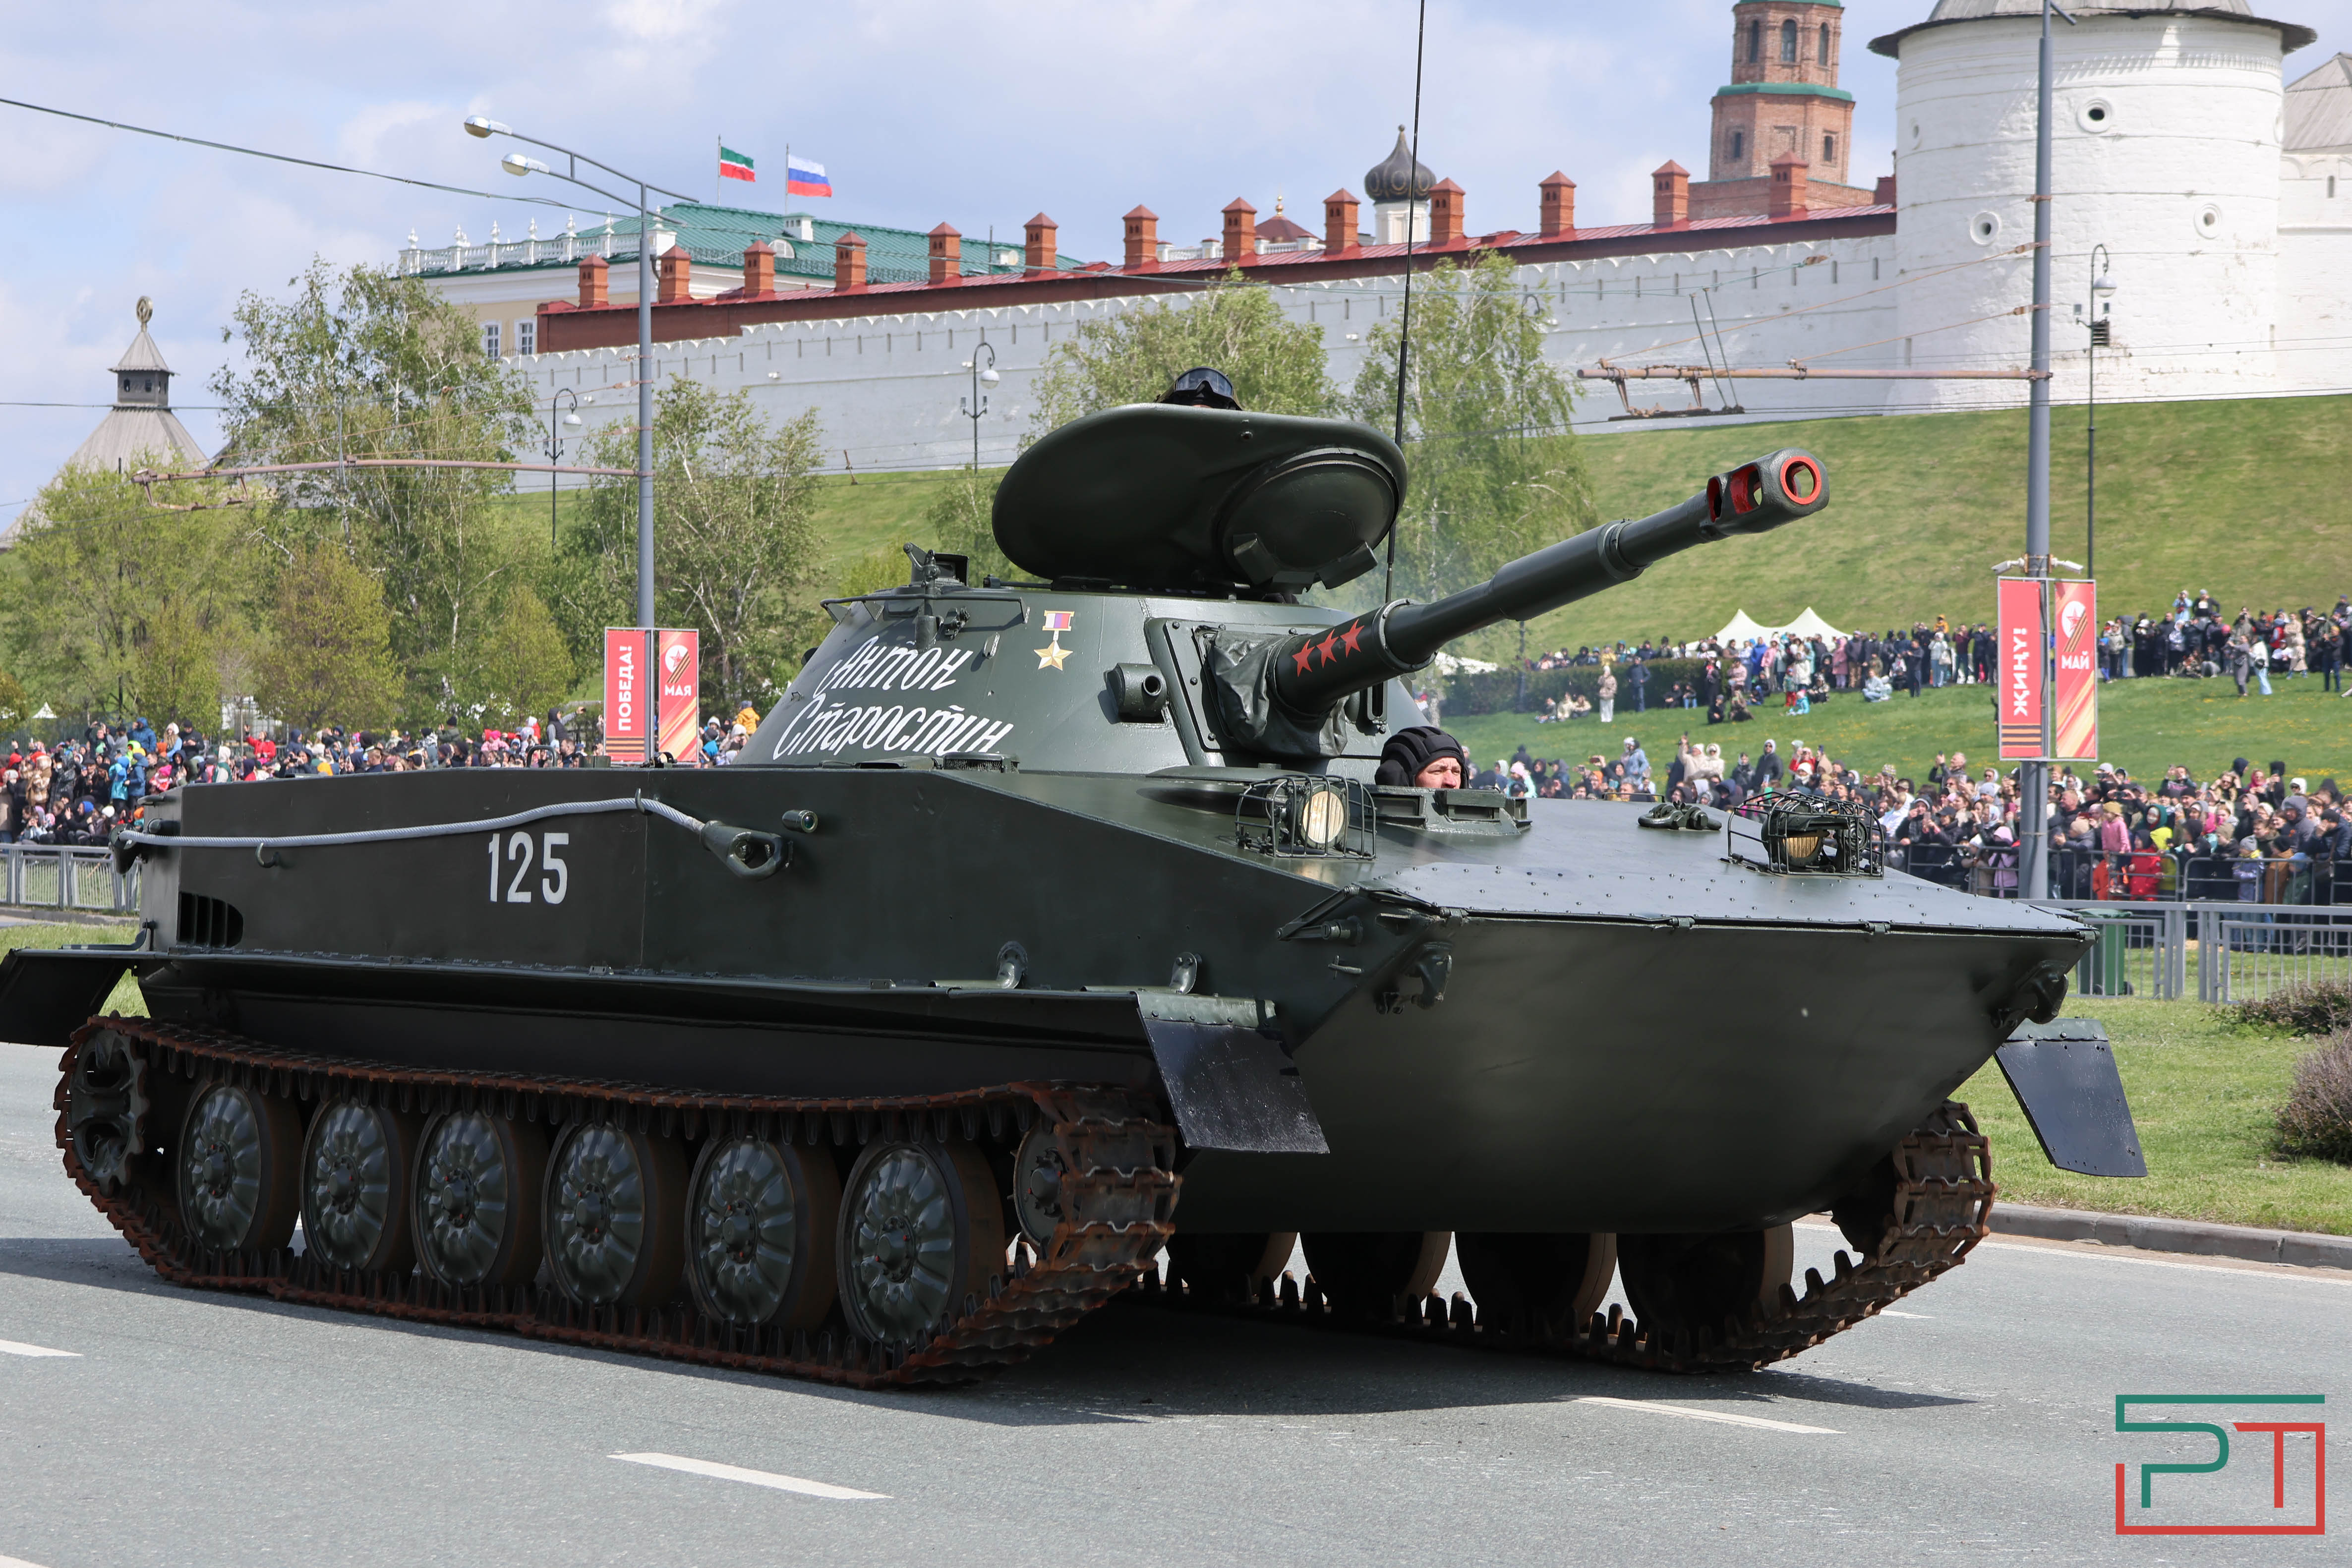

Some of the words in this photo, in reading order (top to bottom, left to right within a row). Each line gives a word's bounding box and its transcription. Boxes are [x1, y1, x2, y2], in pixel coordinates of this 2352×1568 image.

[618, 645, 634, 731] ПОБЕДА!
[664, 685, 692, 696] МАЯ
[813, 635, 973, 699] Антон
[2061, 651, 2090, 669] МАЙ
[773, 693, 1014, 760] Старостин
[488, 831, 569, 904] 125
